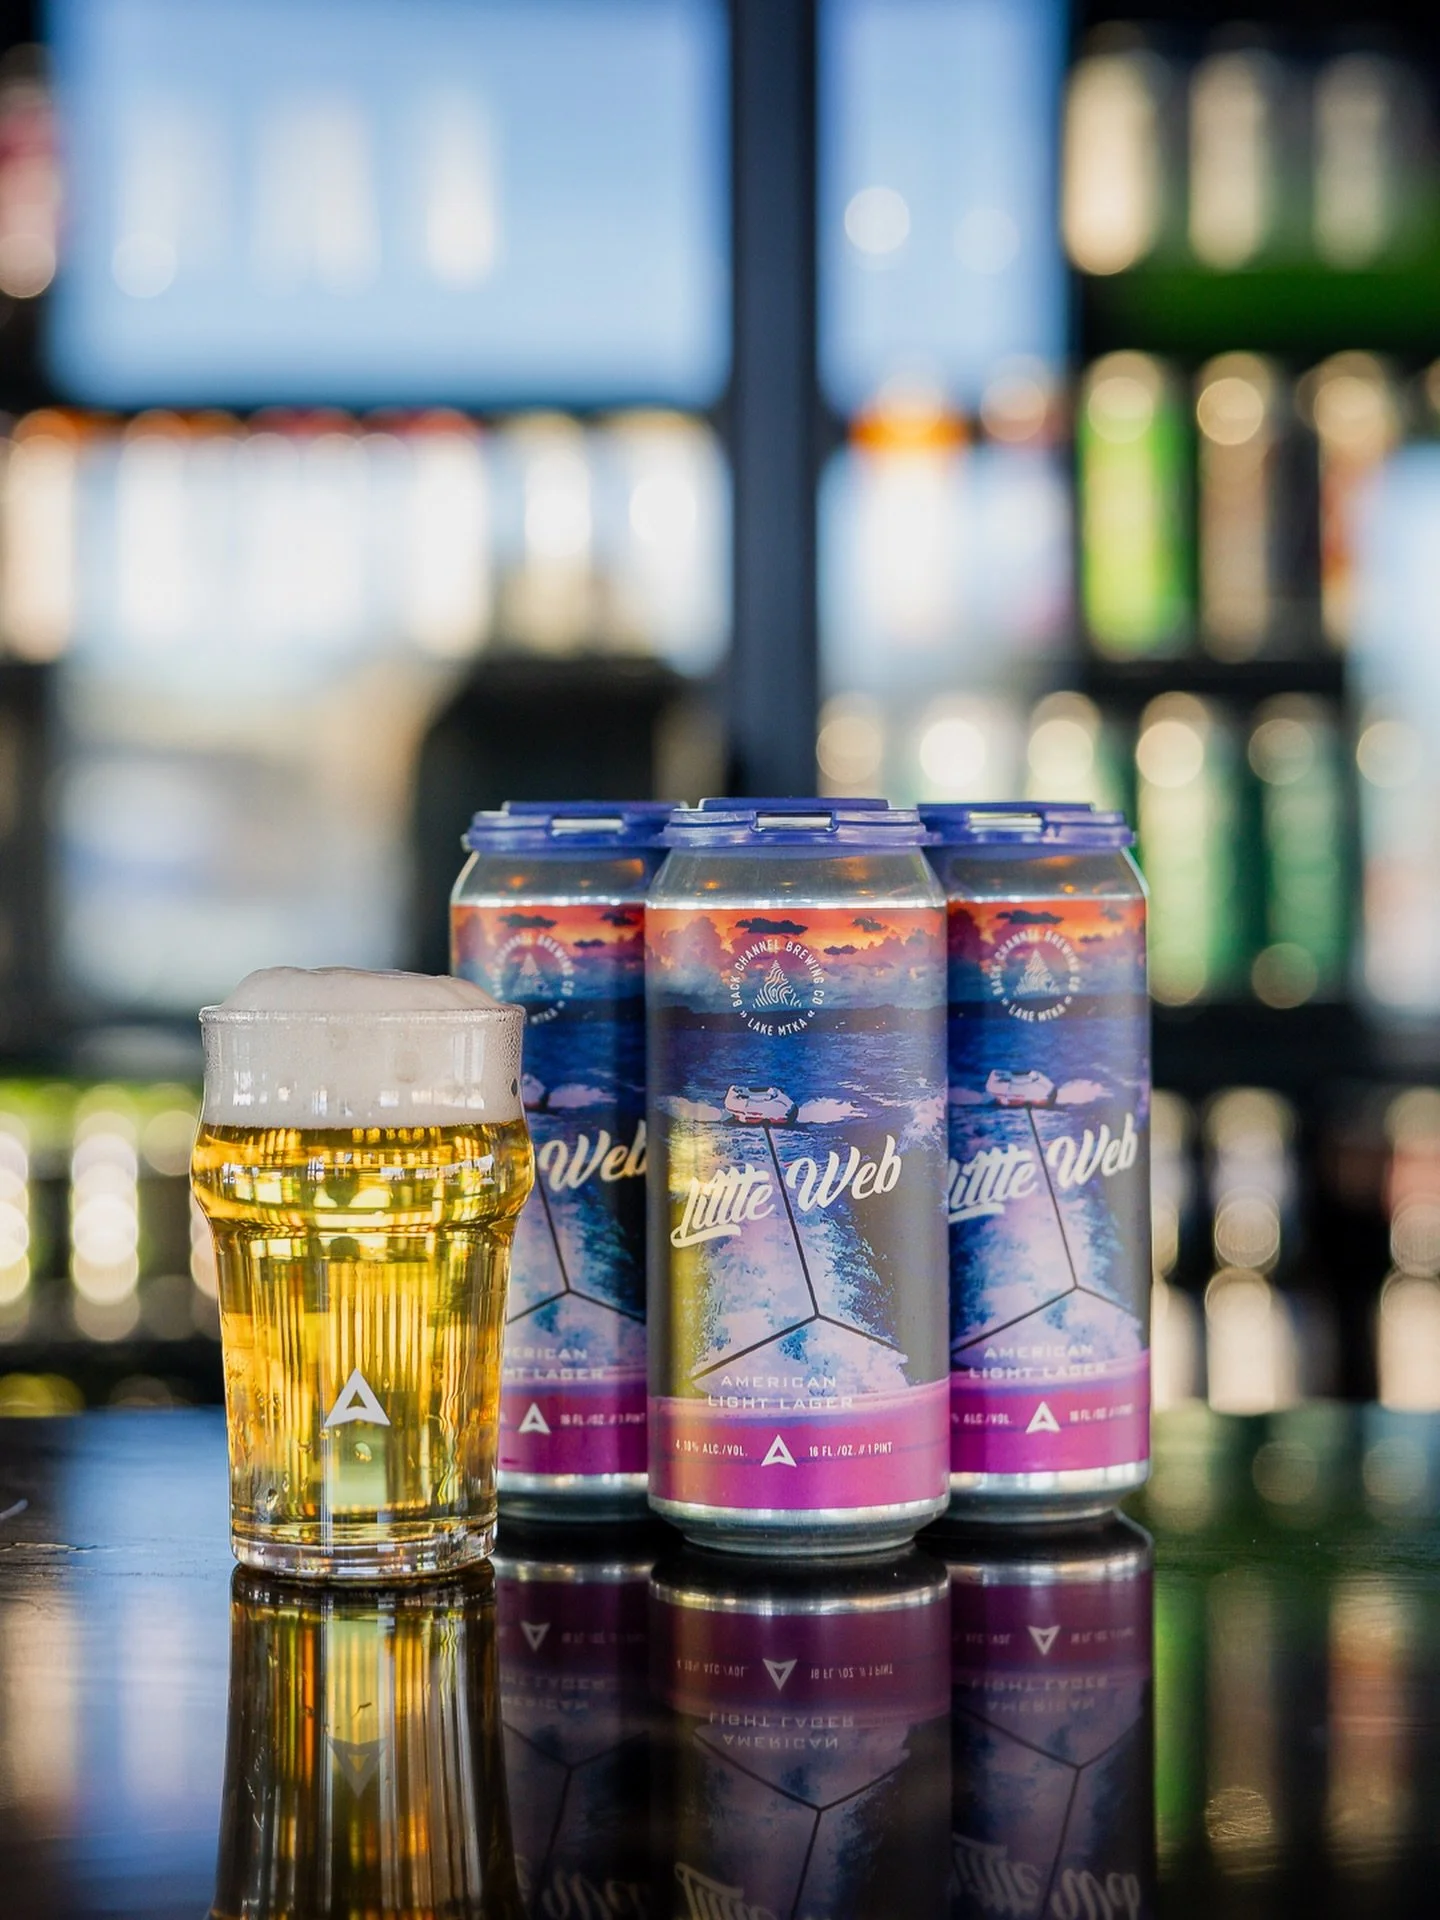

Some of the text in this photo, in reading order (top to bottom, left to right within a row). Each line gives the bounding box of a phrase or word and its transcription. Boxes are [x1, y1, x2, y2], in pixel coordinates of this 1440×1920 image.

[734, 939, 780, 971] CHANNEL
[785, 940, 825, 984] BREWING
[729, 975, 743, 1007] BACK
[747, 1017, 808, 1037] LAKE MTKA
[1046, 1112, 1138, 1189] Web
[670, 1134, 902, 1249] Little Web
[984, 1344, 1094, 1360] AMERICAN
[720, 1375, 837, 1389] AMERICAN
[969, 1362, 1107, 1380] LIGHT LAGER
[707, 1395, 854, 1410] LIGHT LAGER
